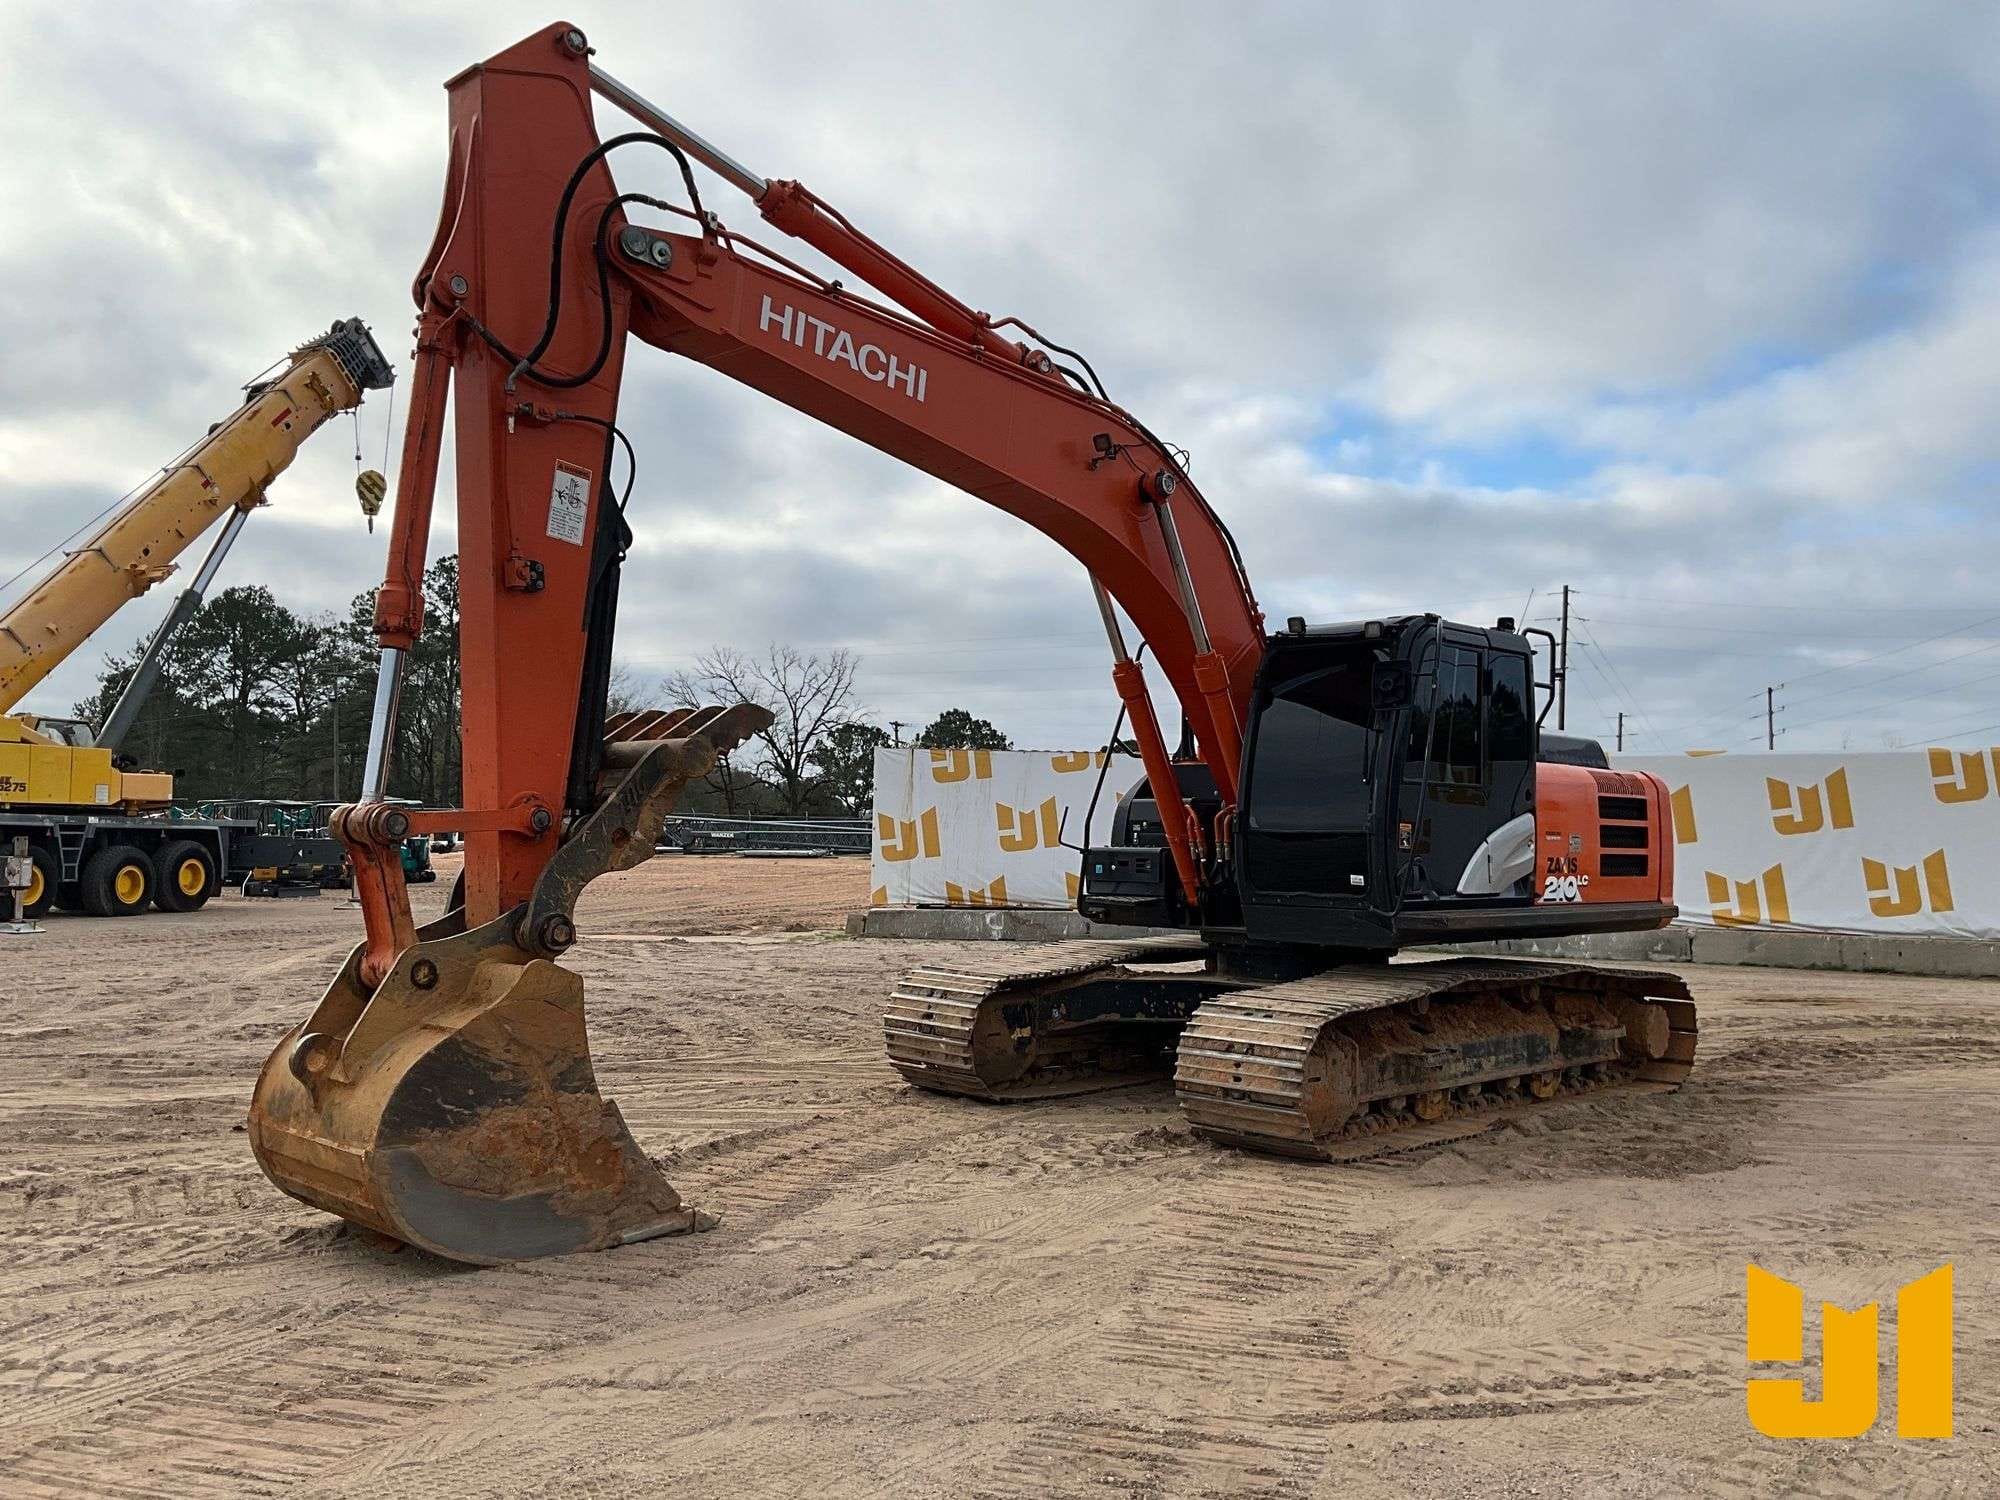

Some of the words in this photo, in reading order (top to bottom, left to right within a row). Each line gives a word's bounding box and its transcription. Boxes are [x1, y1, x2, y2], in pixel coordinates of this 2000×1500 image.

[760, 294, 928, 403] HITACHI
[155, 643, 172, 666] 275
[1546, 856, 1578, 874] ZAXIS
